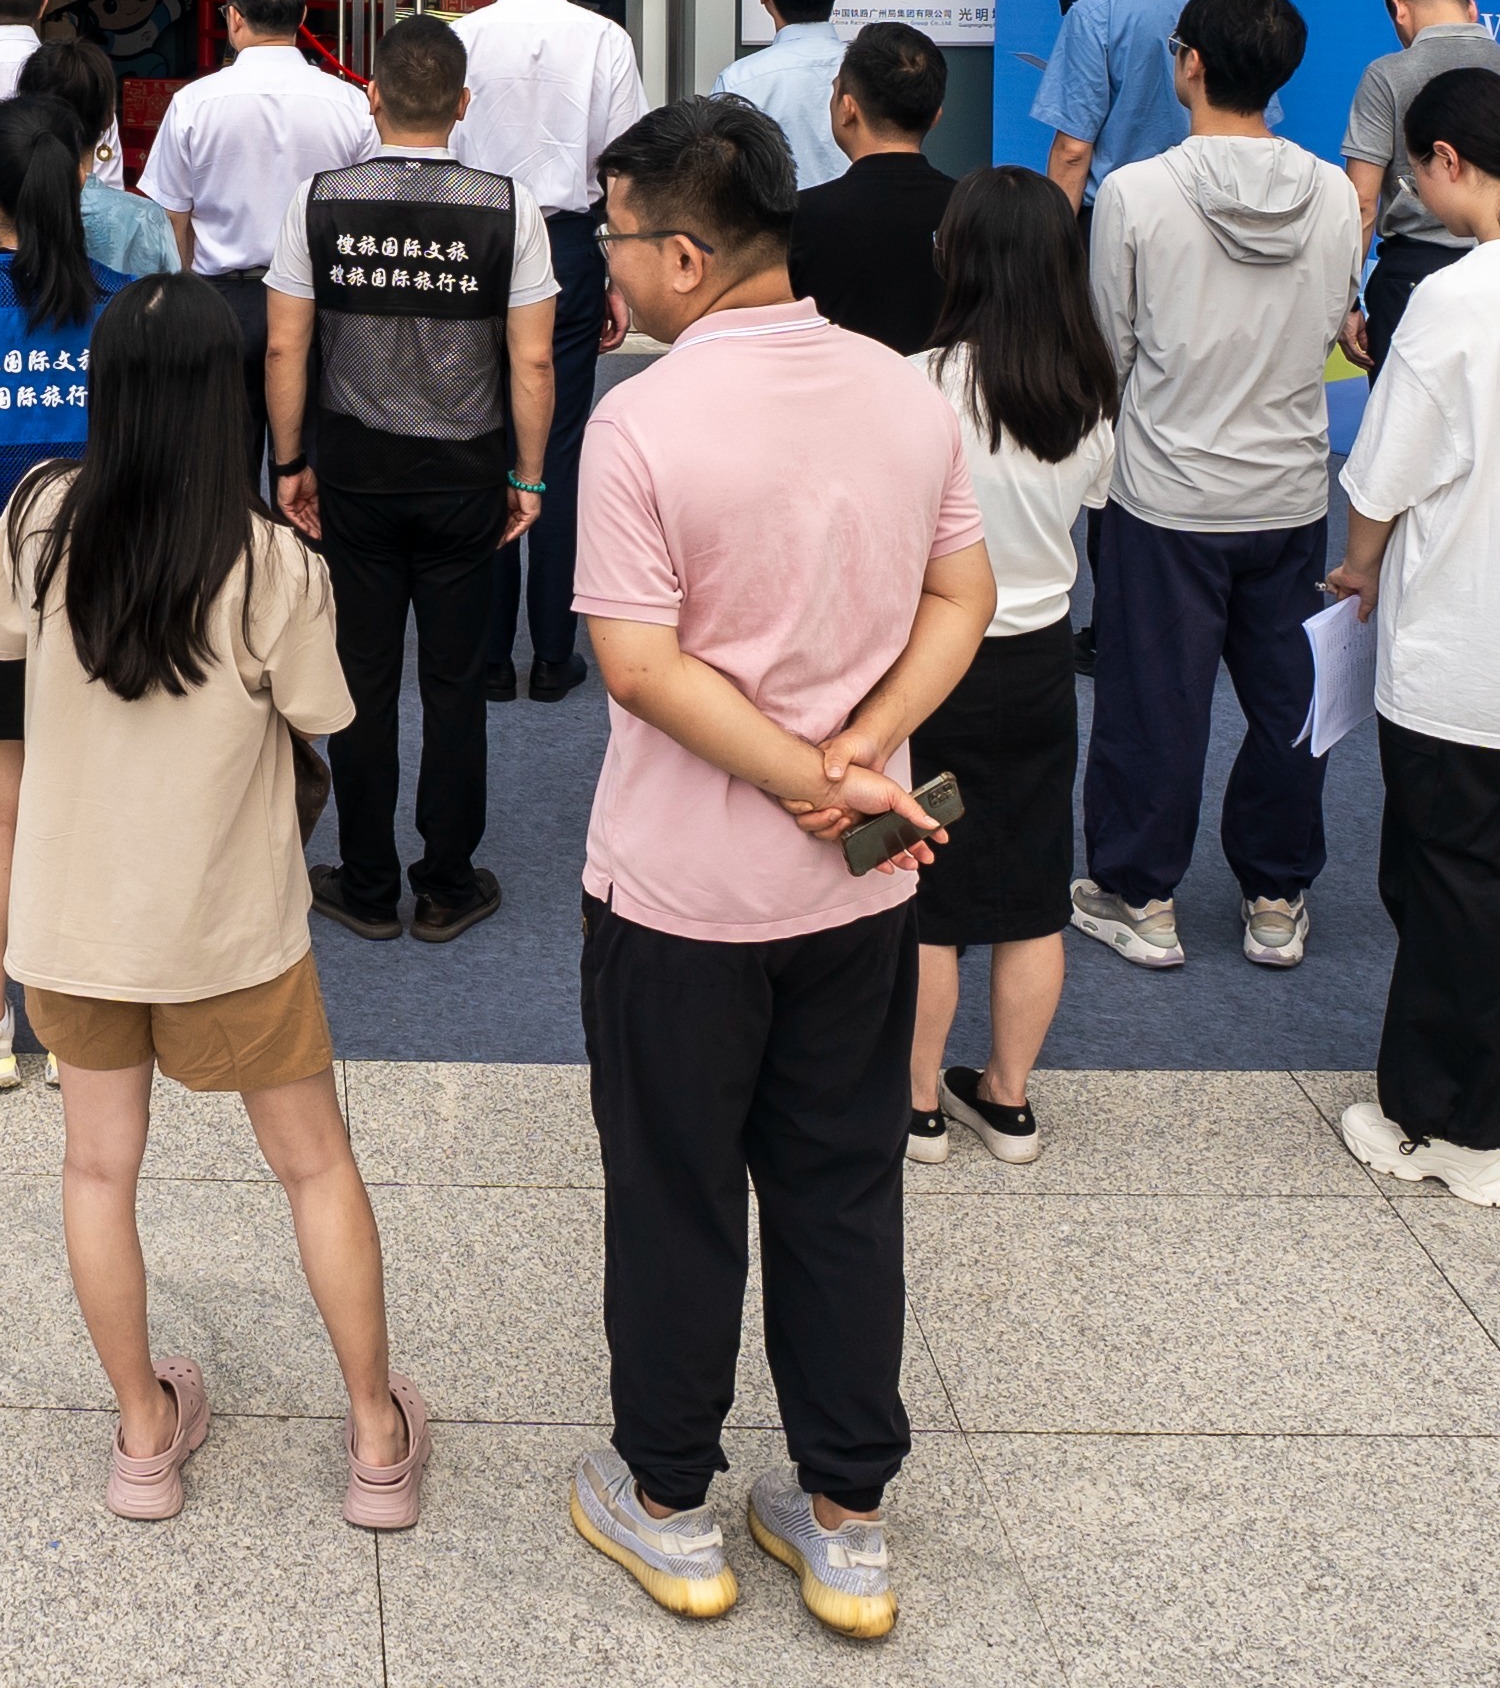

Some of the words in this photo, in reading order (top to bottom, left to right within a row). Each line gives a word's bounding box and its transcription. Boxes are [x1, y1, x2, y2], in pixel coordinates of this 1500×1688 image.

[336, 233, 470, 263] 搜旅国际文旅
[329, 264, 480, 294] 搜旅国际旅行社
